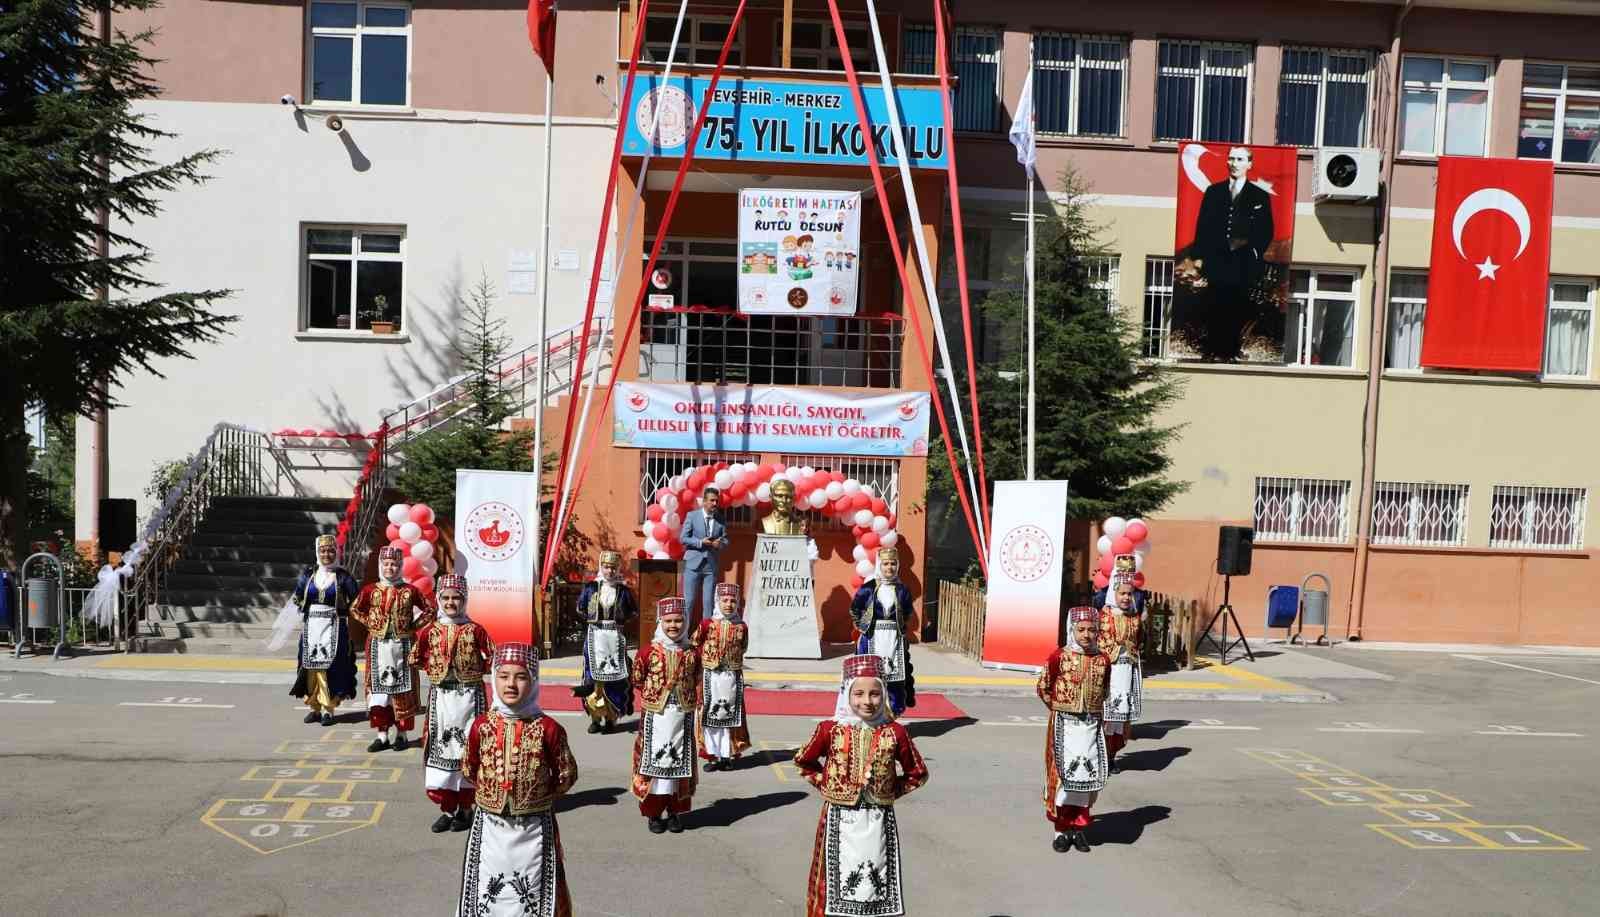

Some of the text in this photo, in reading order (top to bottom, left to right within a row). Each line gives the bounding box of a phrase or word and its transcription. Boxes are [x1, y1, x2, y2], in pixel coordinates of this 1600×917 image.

[785, 93, 841, 109] MERKEZ
[703, 116, 742, 151] 75.
[752, 118, 795, 152] YIL
[674, 402, 715, 415] OKUL
[638, 418, 688, 432] ULUSU
[694, 421, 712, 433] VE
[772, 423, 832, 437] SEVMEYİ
[838, 423, 905, 439] ÖĞRETİR.
[761, 541, 778, 554] NE
[759, 560, 800, 572] MUTLU
[761, 575, 809, 591] TÜRKÜM
[325, 805, 355, 817] 8
[1409, 829, 1452, 843] 8
